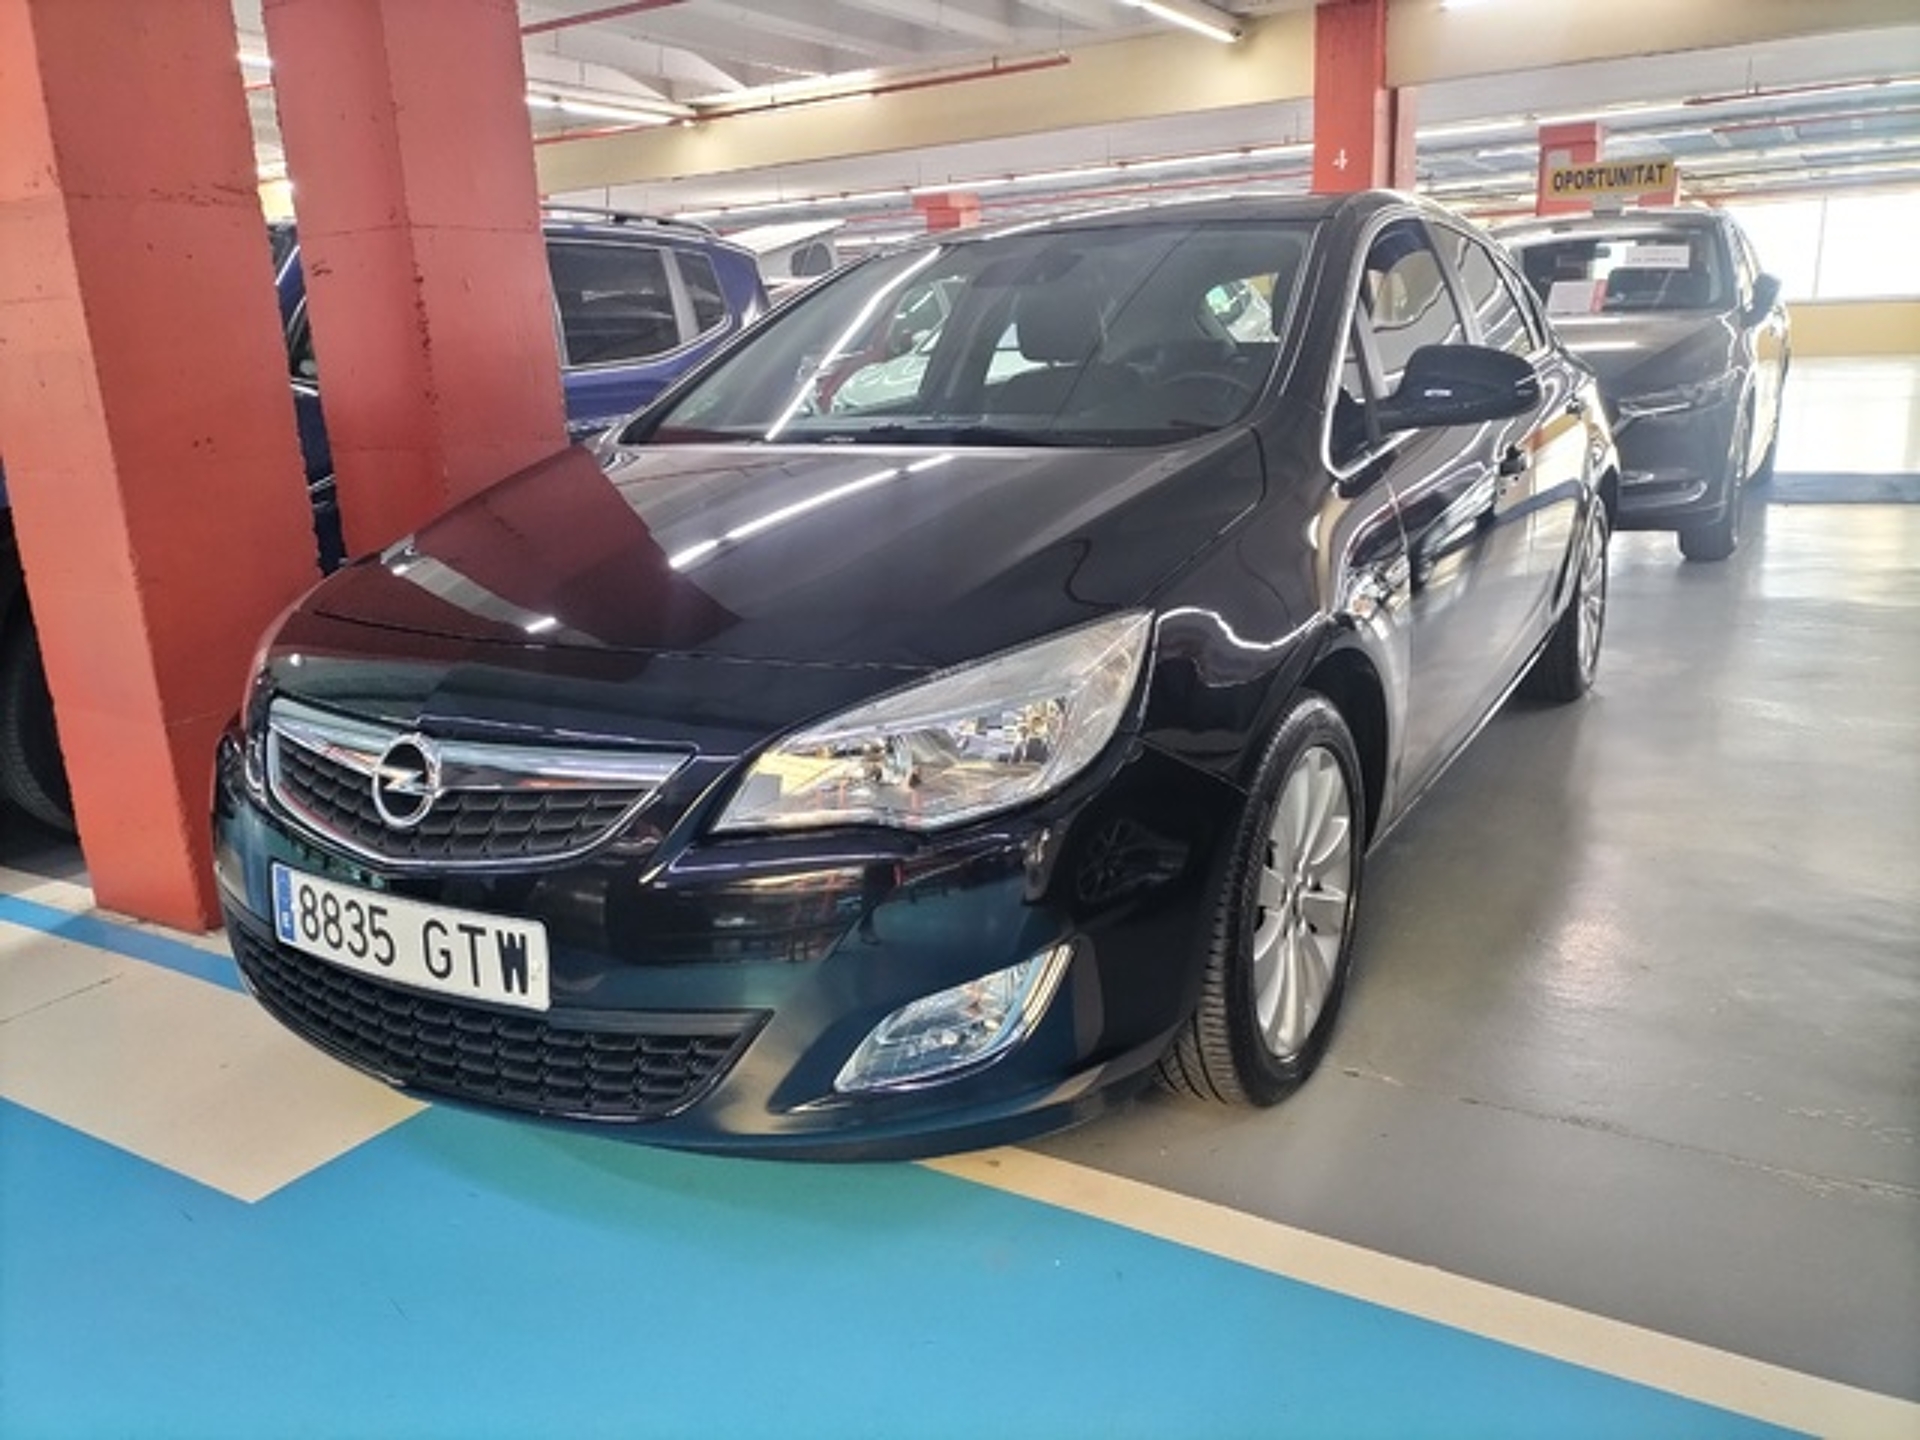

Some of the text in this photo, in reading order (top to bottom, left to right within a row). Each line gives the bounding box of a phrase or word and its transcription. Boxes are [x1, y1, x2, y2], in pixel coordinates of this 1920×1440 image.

[1553, 163, 1666, 191] OPORTUNITAT
[299, 884, 528, 994] 8835 GTW
